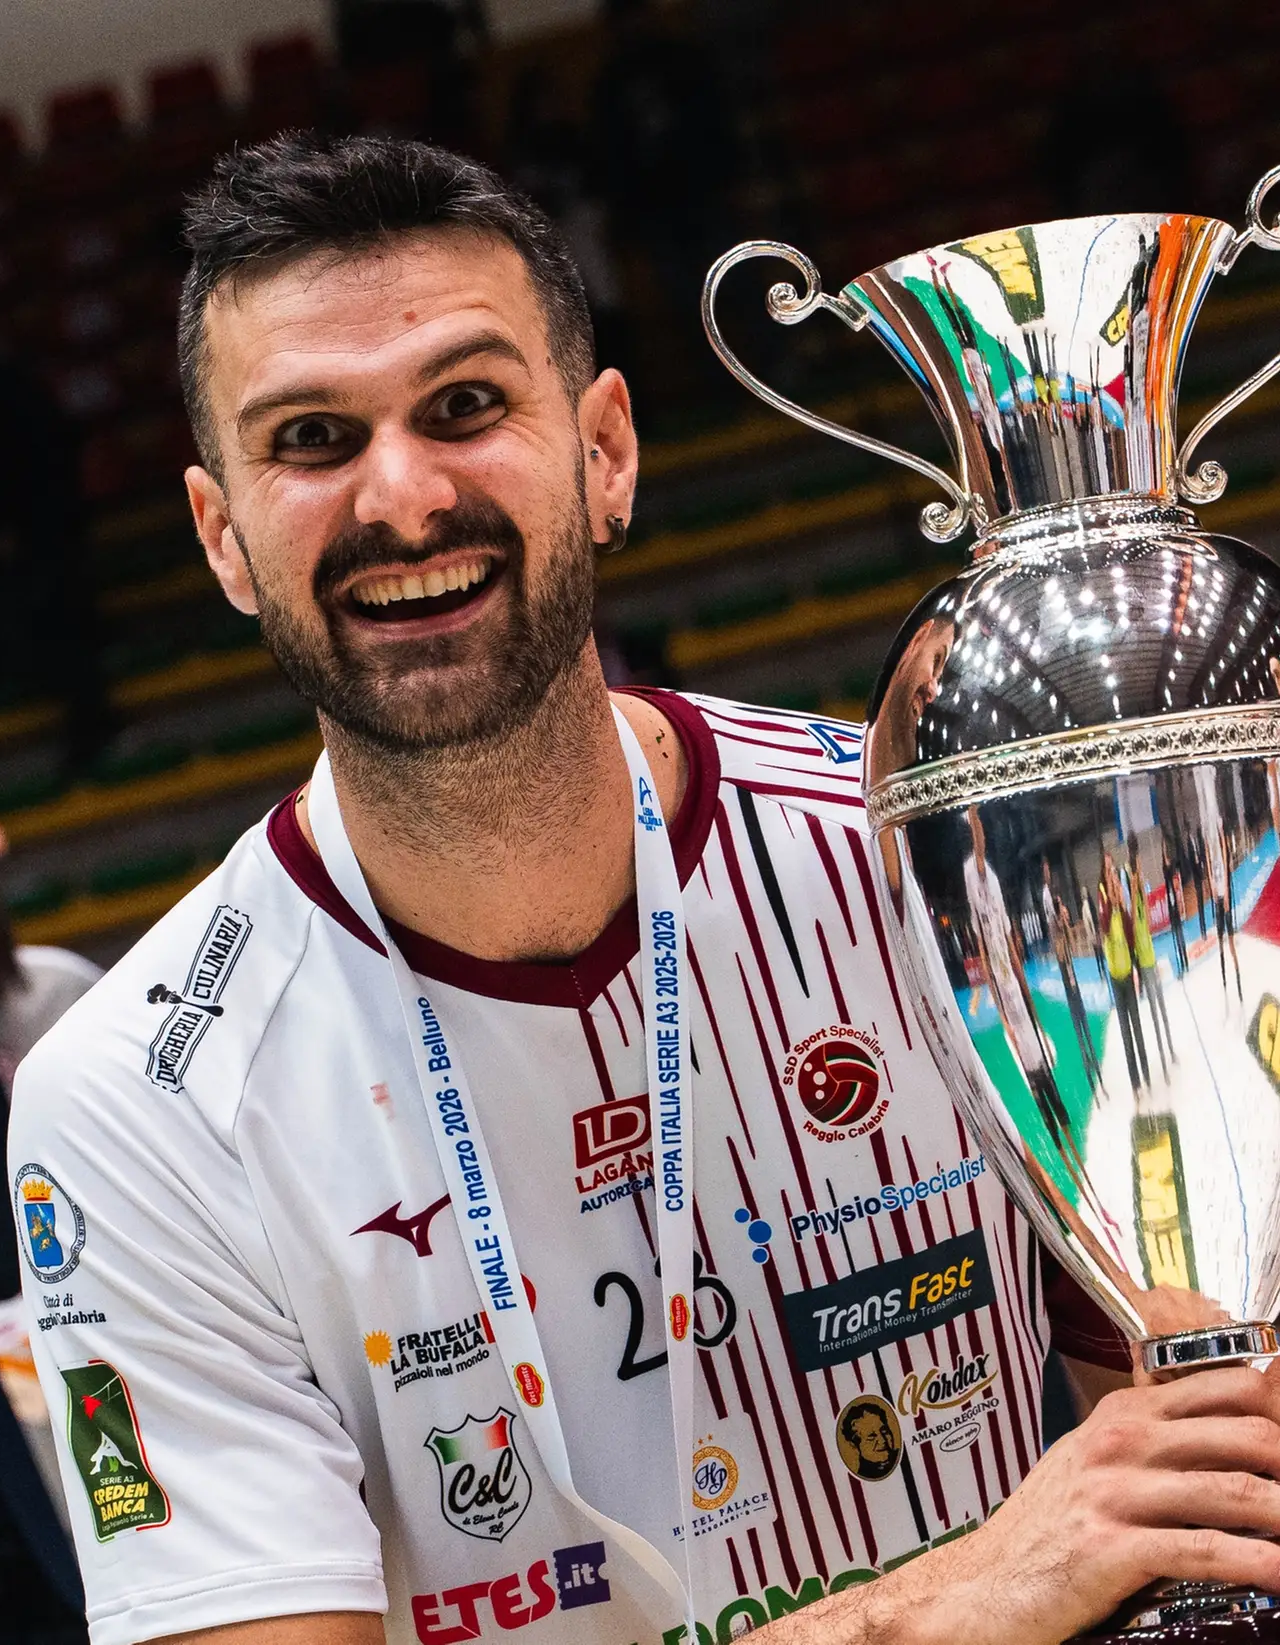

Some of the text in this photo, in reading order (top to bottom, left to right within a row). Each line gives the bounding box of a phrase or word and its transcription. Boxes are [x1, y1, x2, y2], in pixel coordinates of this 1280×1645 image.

[156, 915, 242, 1085] DROGHERIA CULINARIA
[417, 996, 452, 1073] Belluno
[783, 1025, 885, 1086] SSD Sport Specialist
[652, 910, 684, 1212] COPPA ITALIA SERIE A3 2025-2026
[436, 1087, 469, 1137] 2026
[803, 1099, 890, 1143] Reggio Calabria
[455, 1139, 488, 1202] marzo
[468, 1205, 492, 1220] 8
[791, 1153, 987, 1240] PhysioSpecialist
[475, 1234, 517, 1312] FINALE
[63, 1293, 73, 1307] di
[812, 1256, 974, 1342] Trans Fast
[819, 1288, 973, 1353] International Money Transmitter
[390, 1331, 486, 1375] LA BUFALA
[397, 1313, 481, 1354] FRATELLI
[394, 1348, 490, 1392] pizzaioli nel mondo
[911, 1398, 999, 1445] AMARO REGGINO
[93, 1481, 149, 1506] CREDEM
[100, 1475, 134, 1486] SERIE A3
[448, 1447, 517, 1514] C&C
[100, 1498, 145, 1522] BANCA
[673, 1492, 769, 1537] HTEL PALACE
